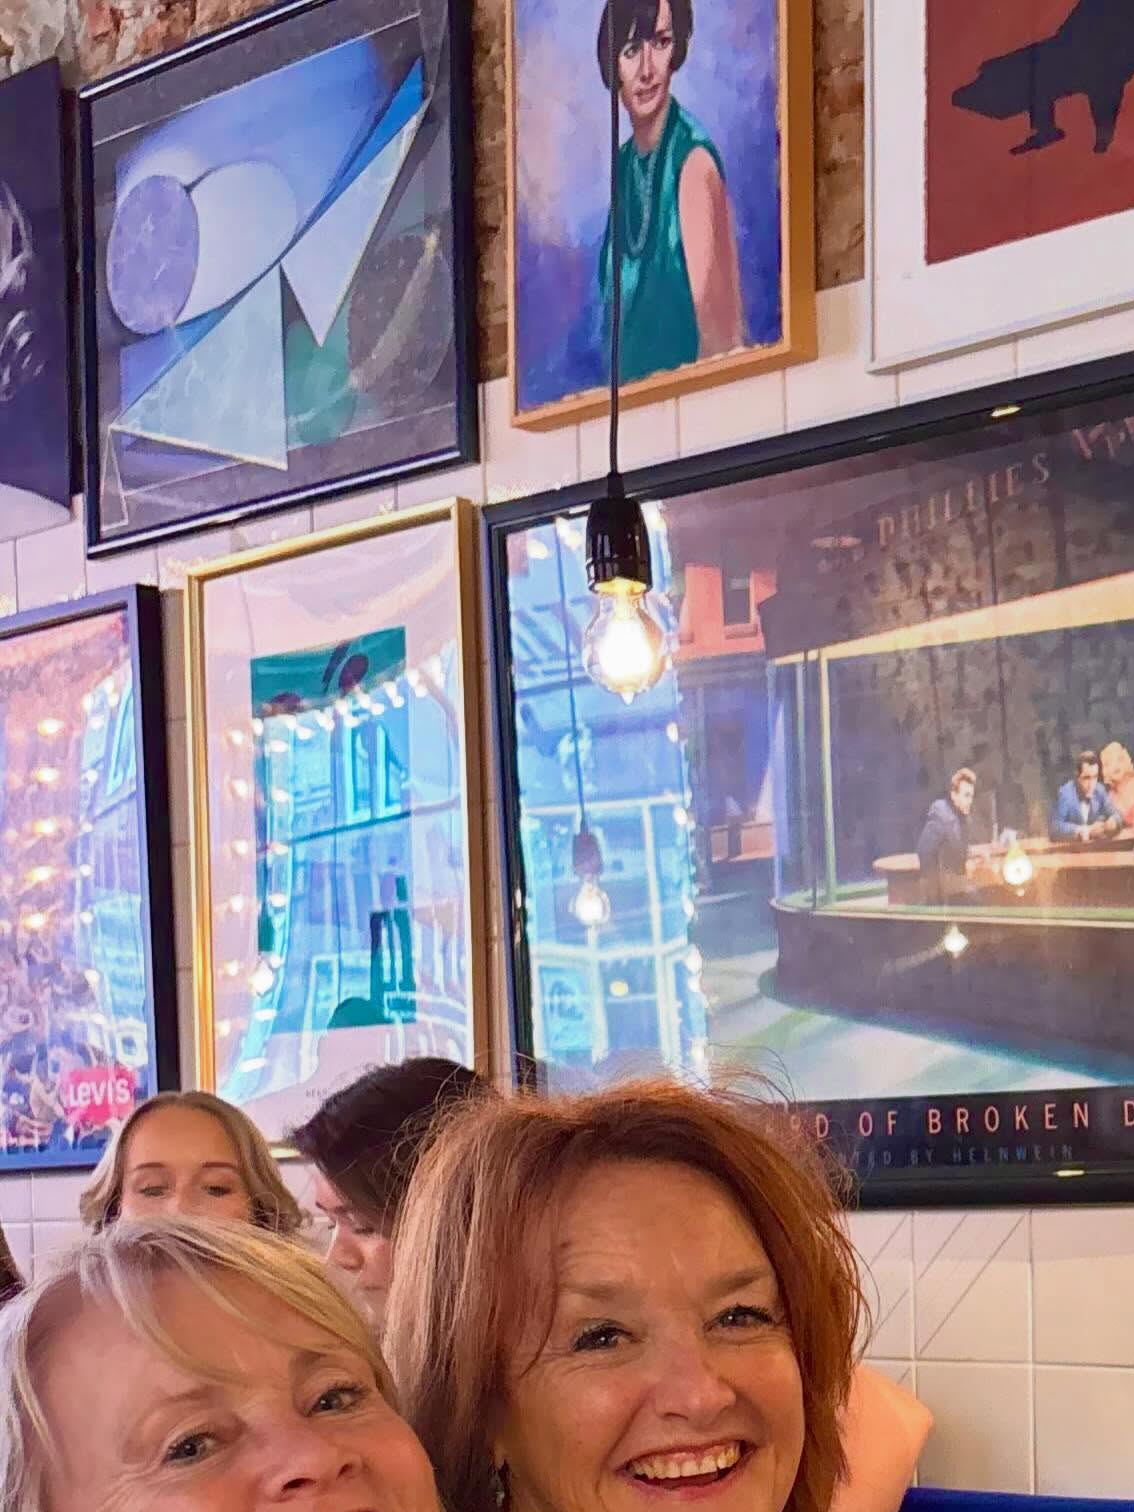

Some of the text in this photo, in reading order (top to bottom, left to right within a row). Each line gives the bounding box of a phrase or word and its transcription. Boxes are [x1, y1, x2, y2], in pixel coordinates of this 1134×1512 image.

[876, 452, 1050, 547] PHILLIES
[859, 1110, 898, 1138] OF
[927, 1102, 1090, 1136] BROKEN
[910, 1149, 935, 1167] BY
[951, 1143, 1074, 1166] HELNWEIN
